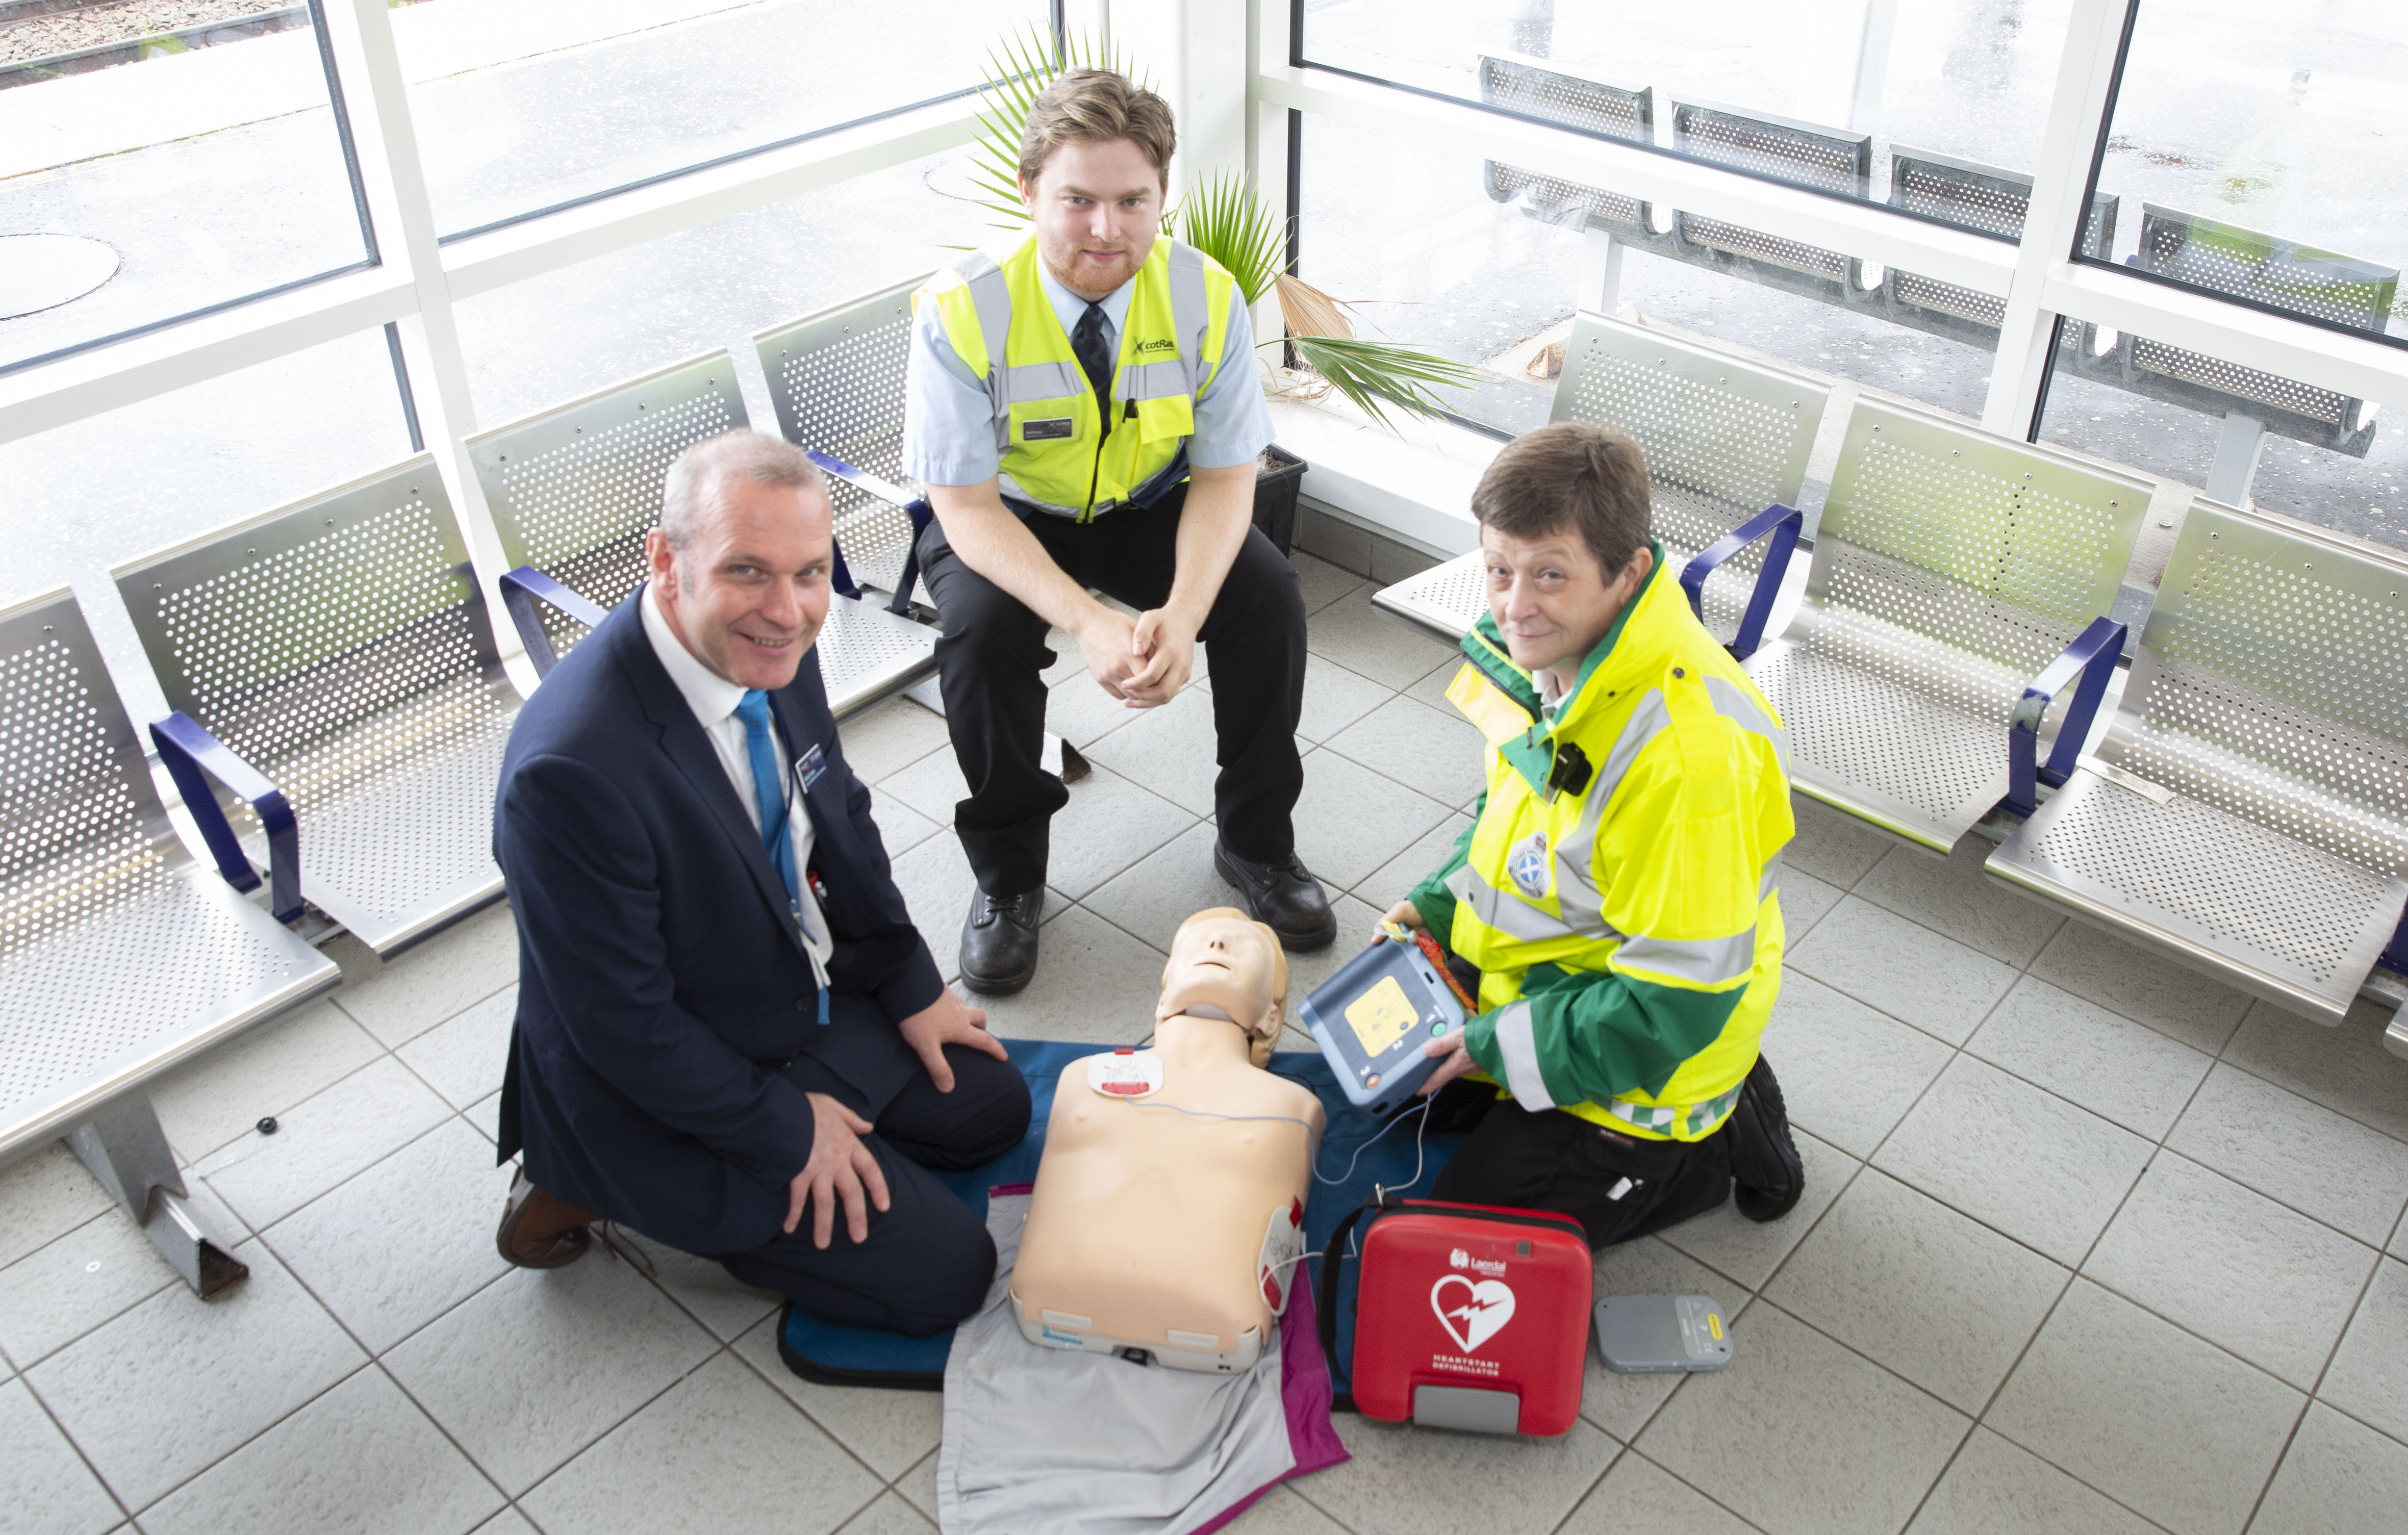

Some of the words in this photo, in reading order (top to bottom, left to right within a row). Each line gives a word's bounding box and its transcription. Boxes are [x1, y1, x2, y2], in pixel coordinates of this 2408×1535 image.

[1426, 1014, 1435, 1023] 1
[1392, 1039, 1403, 1051] 2
[1360, 1065, 1371, 1077] 3
[1471, 1257, 1506, 1271] Laerdal
[1433, 1354, 1500, 1369] HEARTSTART
[1432, 1361, 1500, 1377] DEFIBRILLATOR
